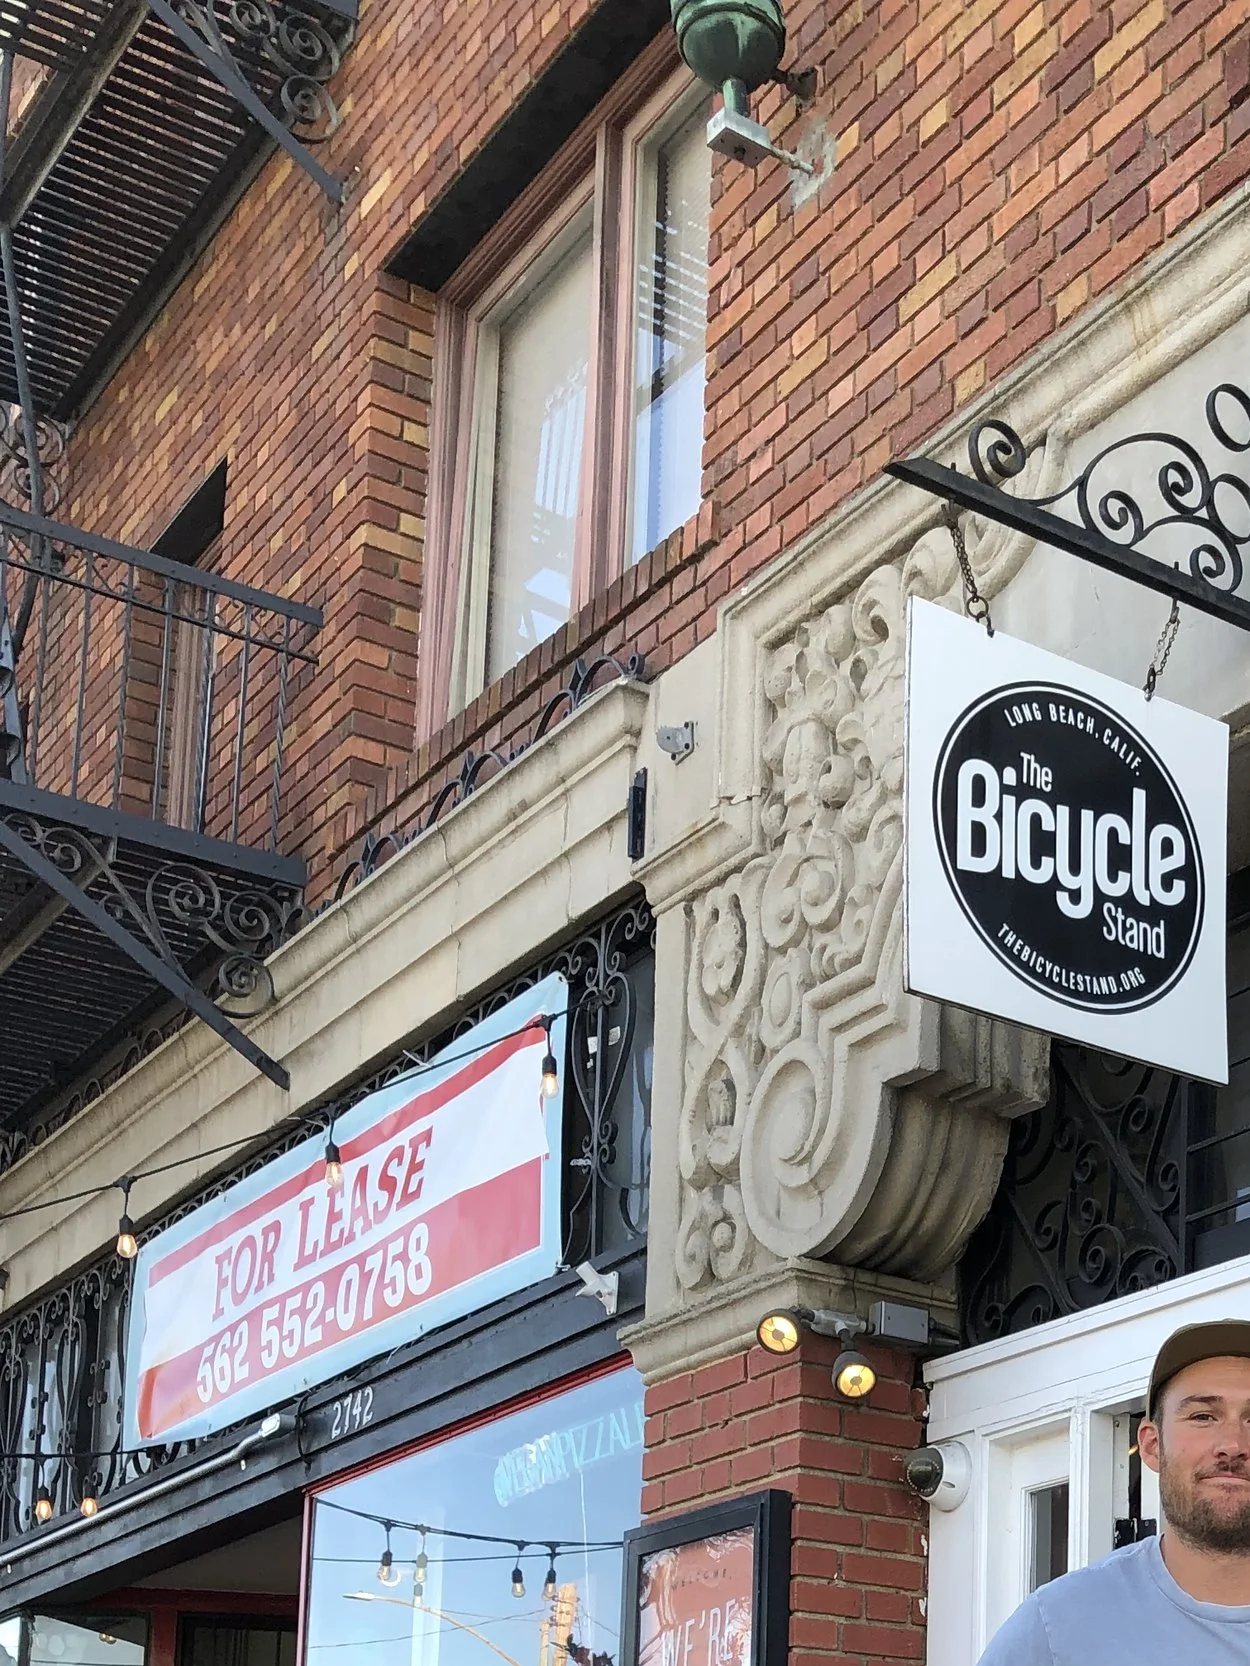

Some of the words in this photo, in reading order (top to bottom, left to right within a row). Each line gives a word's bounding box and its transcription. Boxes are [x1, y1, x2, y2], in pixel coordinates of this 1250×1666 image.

[1004, 702, 1042, 727] LONG
[1049, 704, 1099, 739] BEACH,
[1103, 727, 1143, 776] CALIF.
[1020, 752, 1053, 792] The
[956, 759, 1186, 918] Bicycle
[998, 923, 1146, 995] THEBICYCLESTAND.ORG
[1102, 903, 1166, 959] Stand
[212, 1219, 281, 1323] FOR
[293, 1126, 434, 1271] LEASE
[195, 1327, 250, 1403] 562
[260, 1223, 432, 1370] 552-0758
[332, 1386, 373, 1440] 2742
